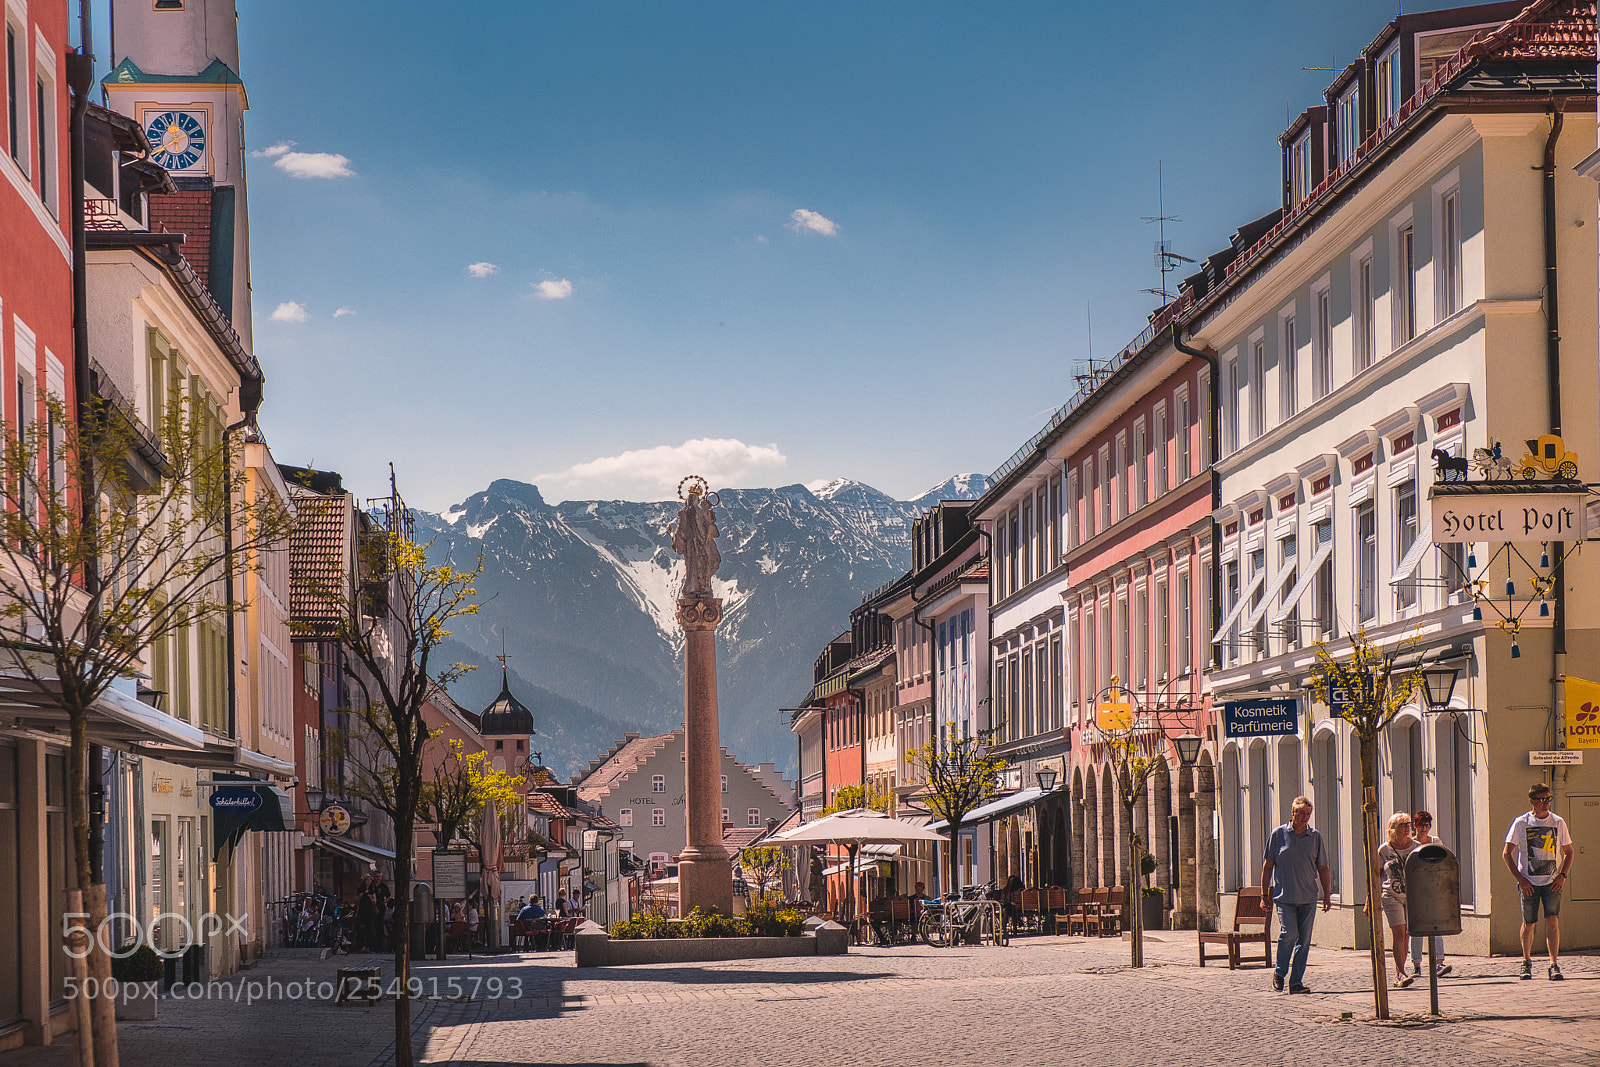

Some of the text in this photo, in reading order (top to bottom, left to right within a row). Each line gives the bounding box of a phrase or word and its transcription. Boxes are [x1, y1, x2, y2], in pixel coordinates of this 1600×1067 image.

[1443, 510, 1504, 537] Hotel
[1234, 705, 1287, 717] Kosmetik
[1230, 720, 1293, 733] Parfümerie
[629, 797, 656, 805] HOTEL
